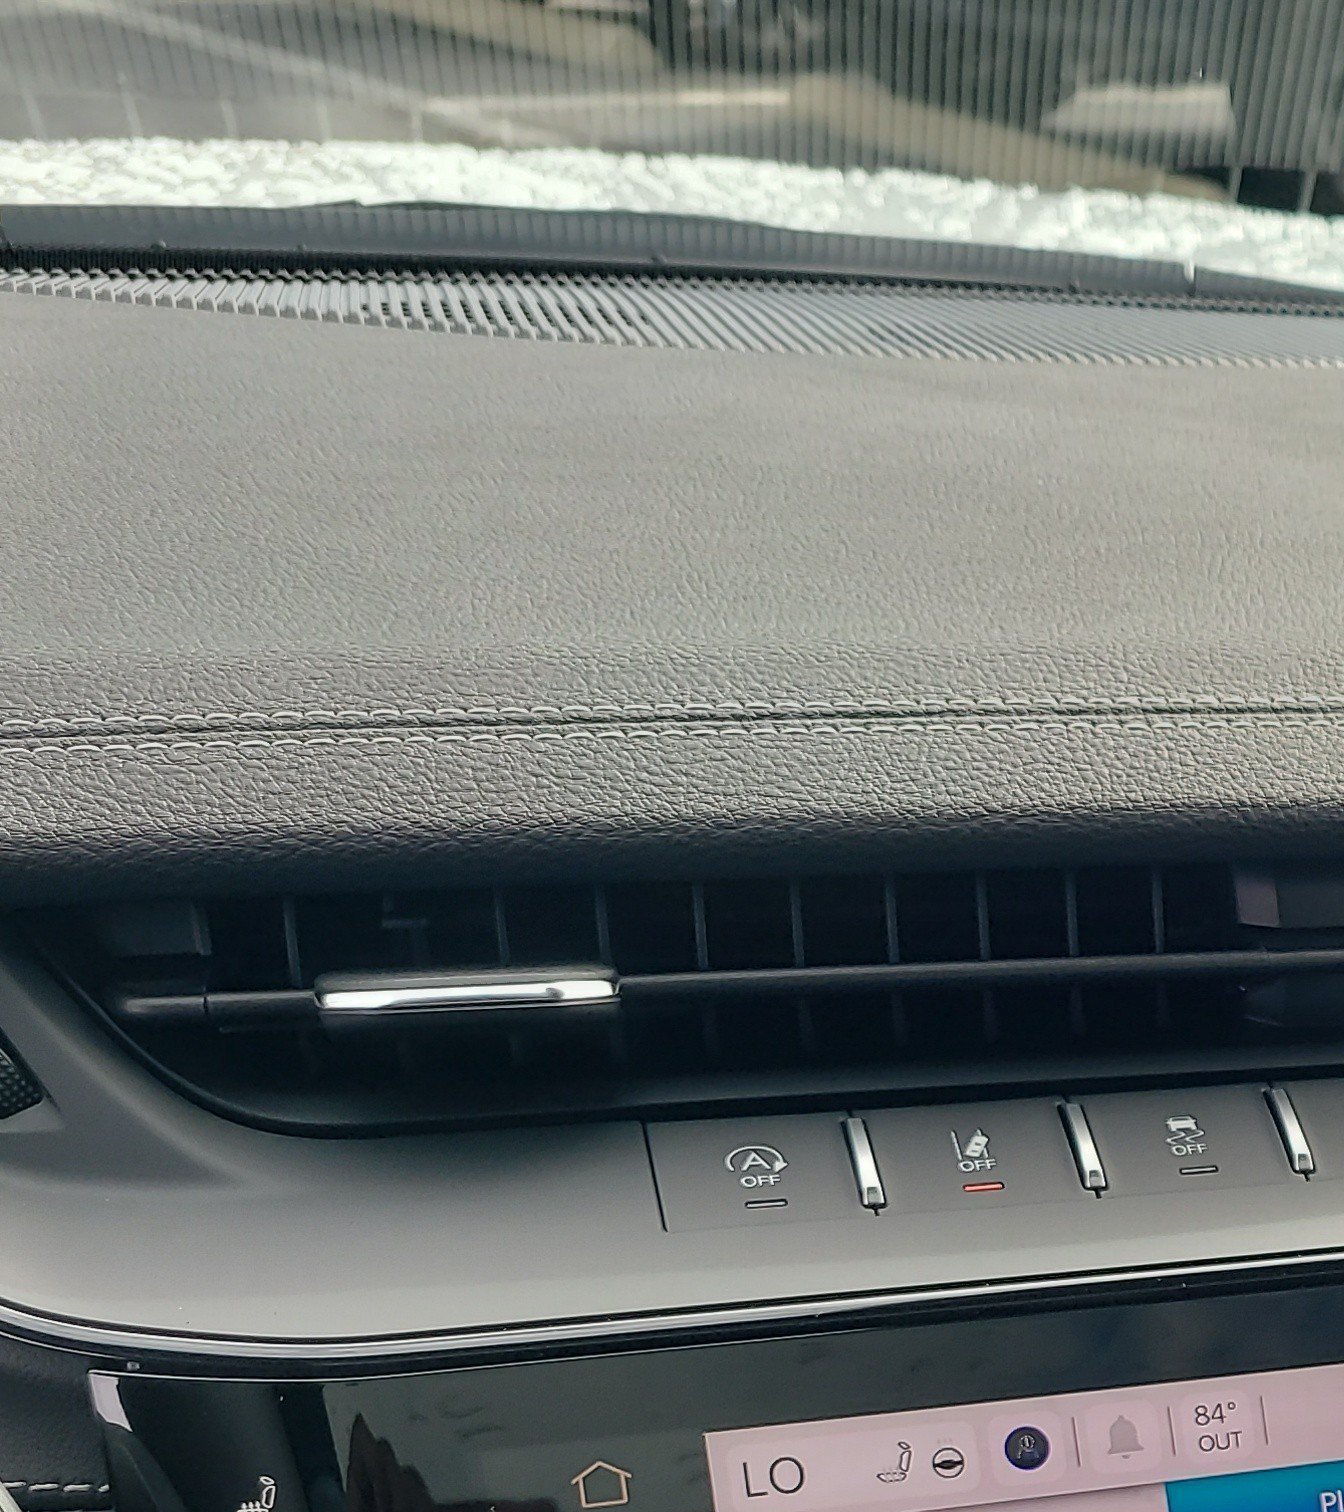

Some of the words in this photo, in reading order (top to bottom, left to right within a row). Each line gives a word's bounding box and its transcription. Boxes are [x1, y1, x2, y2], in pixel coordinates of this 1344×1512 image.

[1170, 1142, 1208, 1157] OFF
[957, 1158, 997, 1174] OFF
[741, 1174, 780, 1188] OFF
[1193, 1401, 1238, 1427] 84°
[1198, 1430, 1243, 1452] OUT
[742, 1455, 806, 1498] LO
